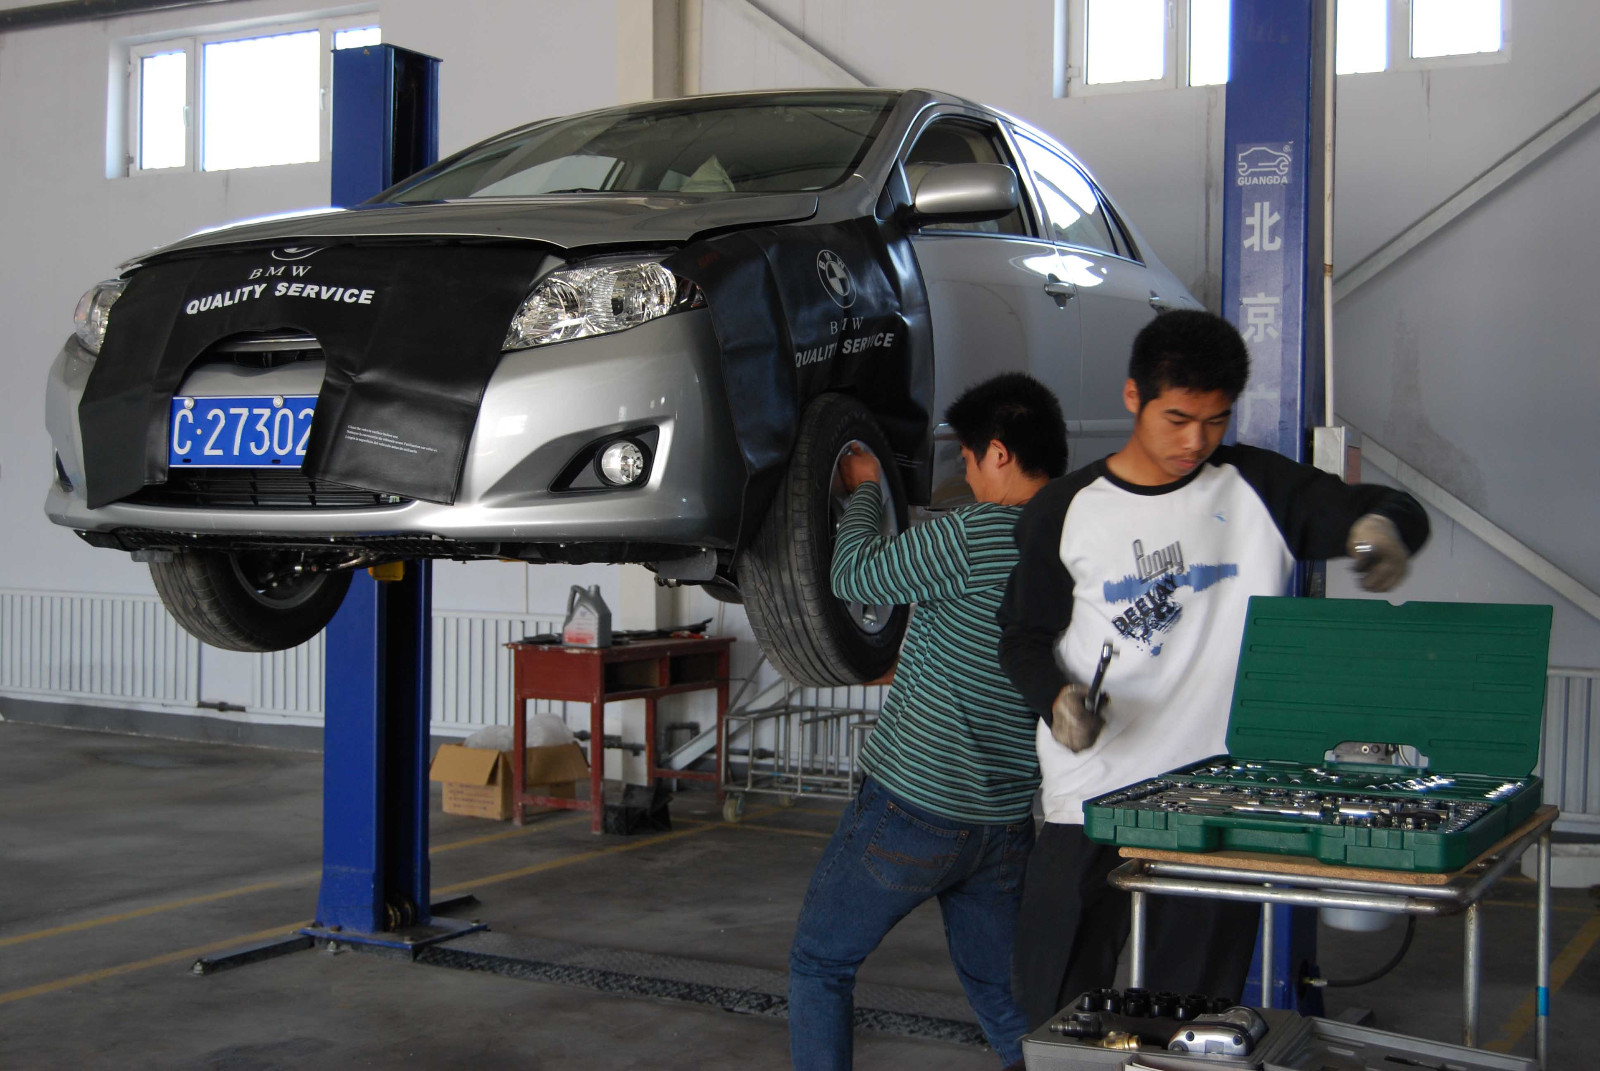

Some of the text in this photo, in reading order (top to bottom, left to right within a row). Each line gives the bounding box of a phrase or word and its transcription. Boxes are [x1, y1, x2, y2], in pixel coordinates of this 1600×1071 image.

[1237, 175, 1289, 186] GUANGDA
[248, 265, 312, 280] BMW
[185, 281, 376, 315] QUALITY SERVICE
